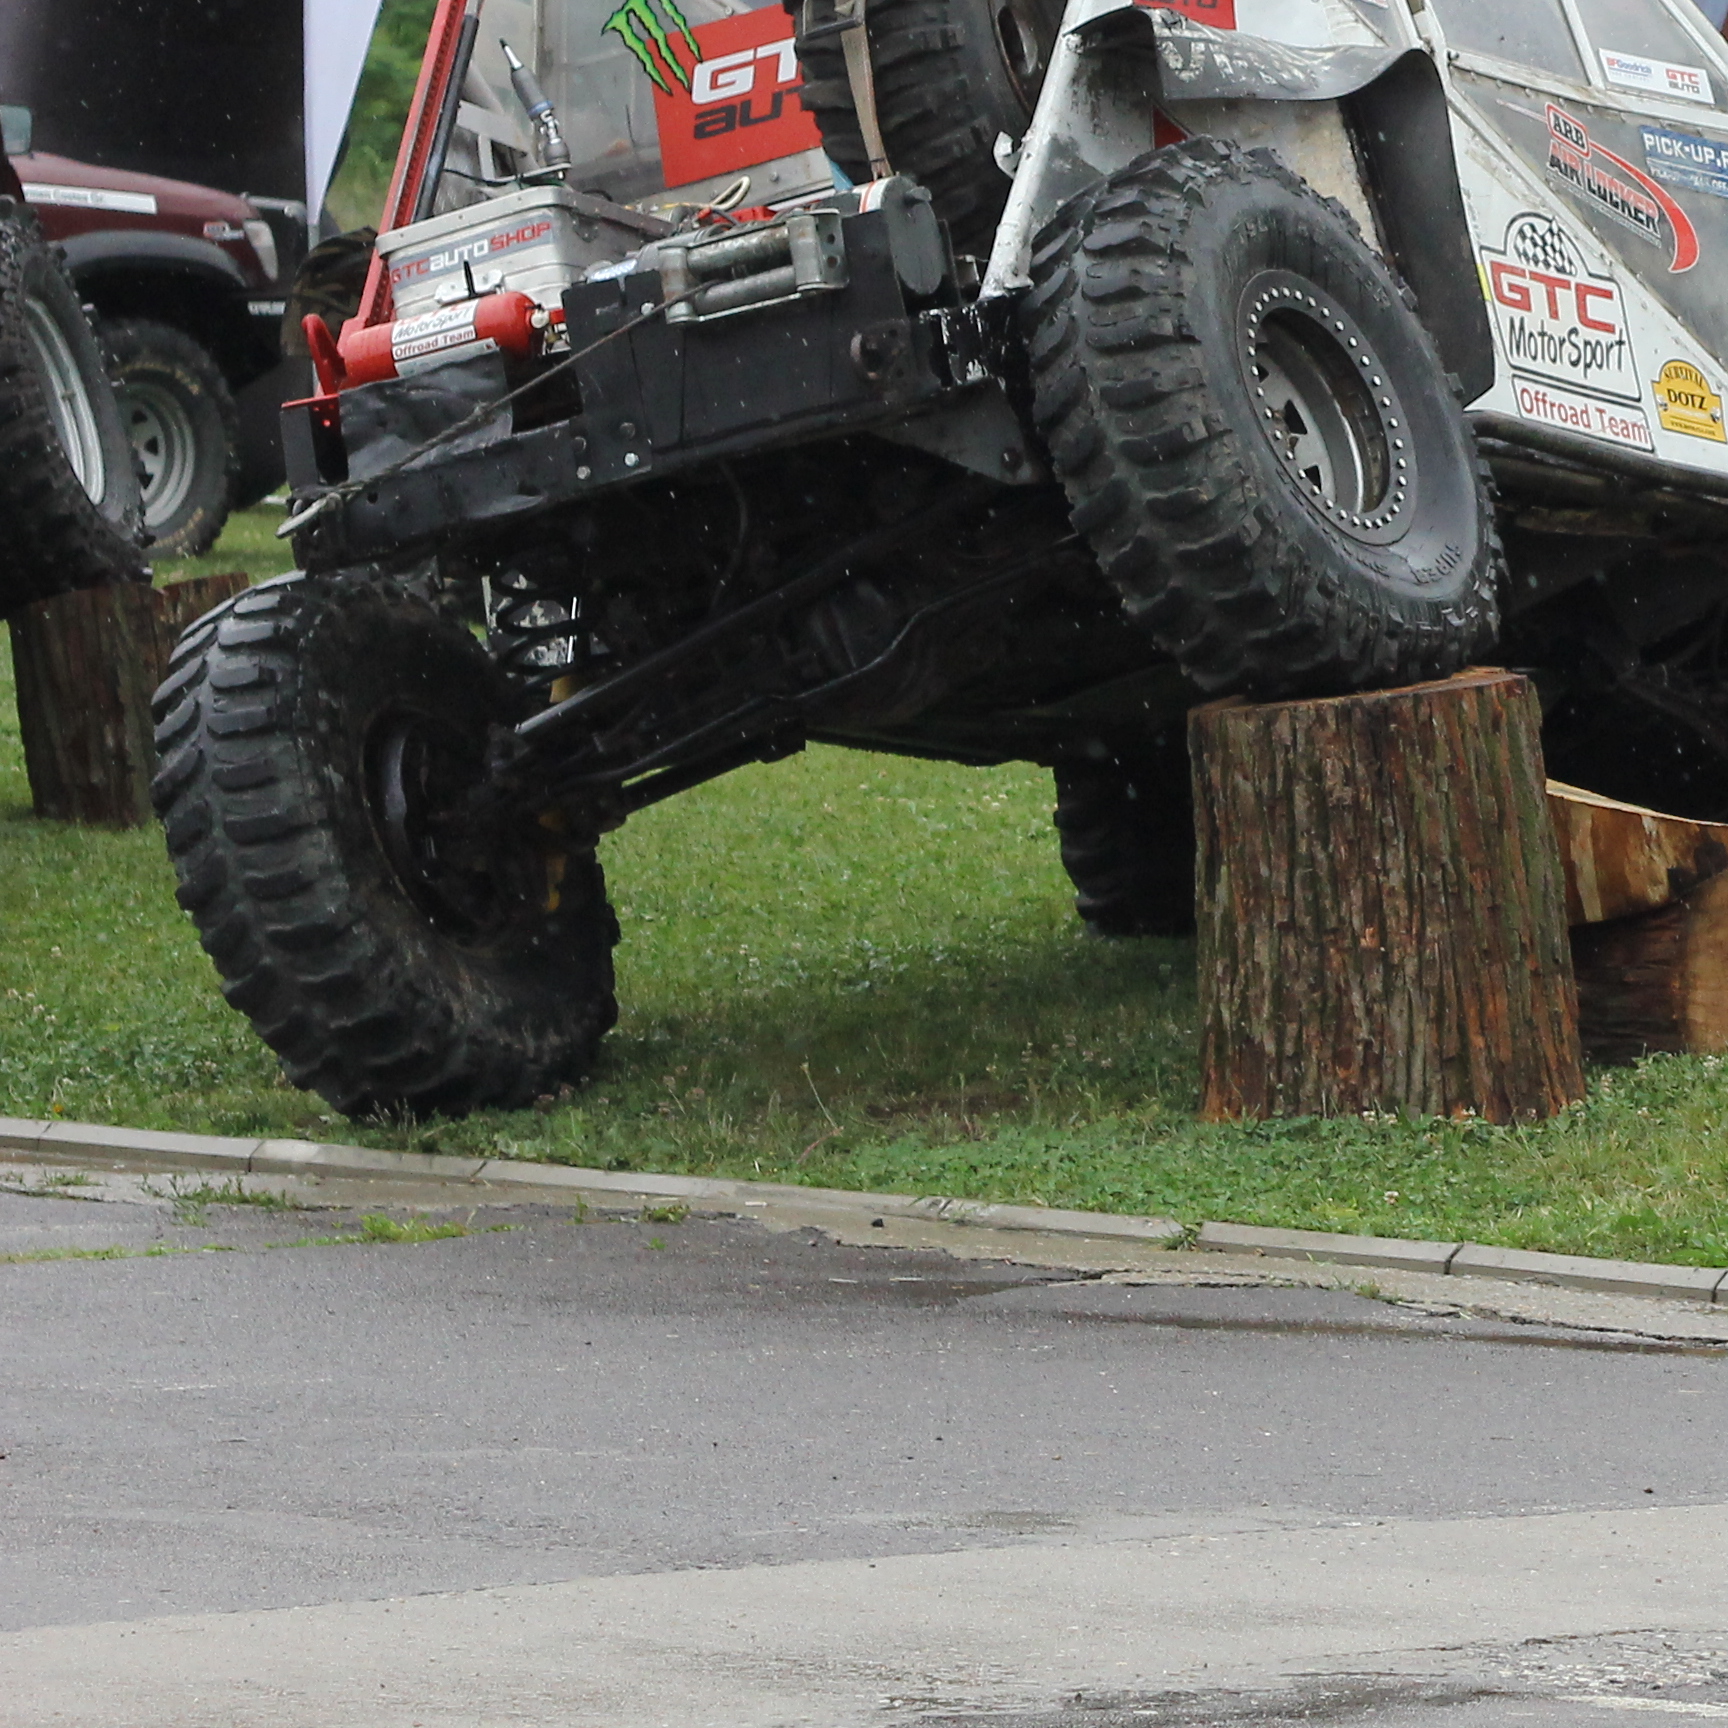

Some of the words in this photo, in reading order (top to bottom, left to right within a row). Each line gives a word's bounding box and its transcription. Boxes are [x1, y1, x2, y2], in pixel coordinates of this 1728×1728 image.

[692, 37, 798, 105] GT
[1666, 68, 1699, 85] GTC
[1552, 113, 1586, 151] ARB
[1548, 140, 1583, 189] AIR
[1584, 161, 1662, 238] LOCKER
[1490, 260, 1616, 335] GTC
[395, 339, 438, 359] Offroad
[442, 329, 475, 345] Team
[1509, 316, 1626, 379] MotorSport
[1520, 388, 1592, 430] Offroad
[1595, 407, 1650, 445] Team
[1666, 388, 1708, 411] DOTZ
